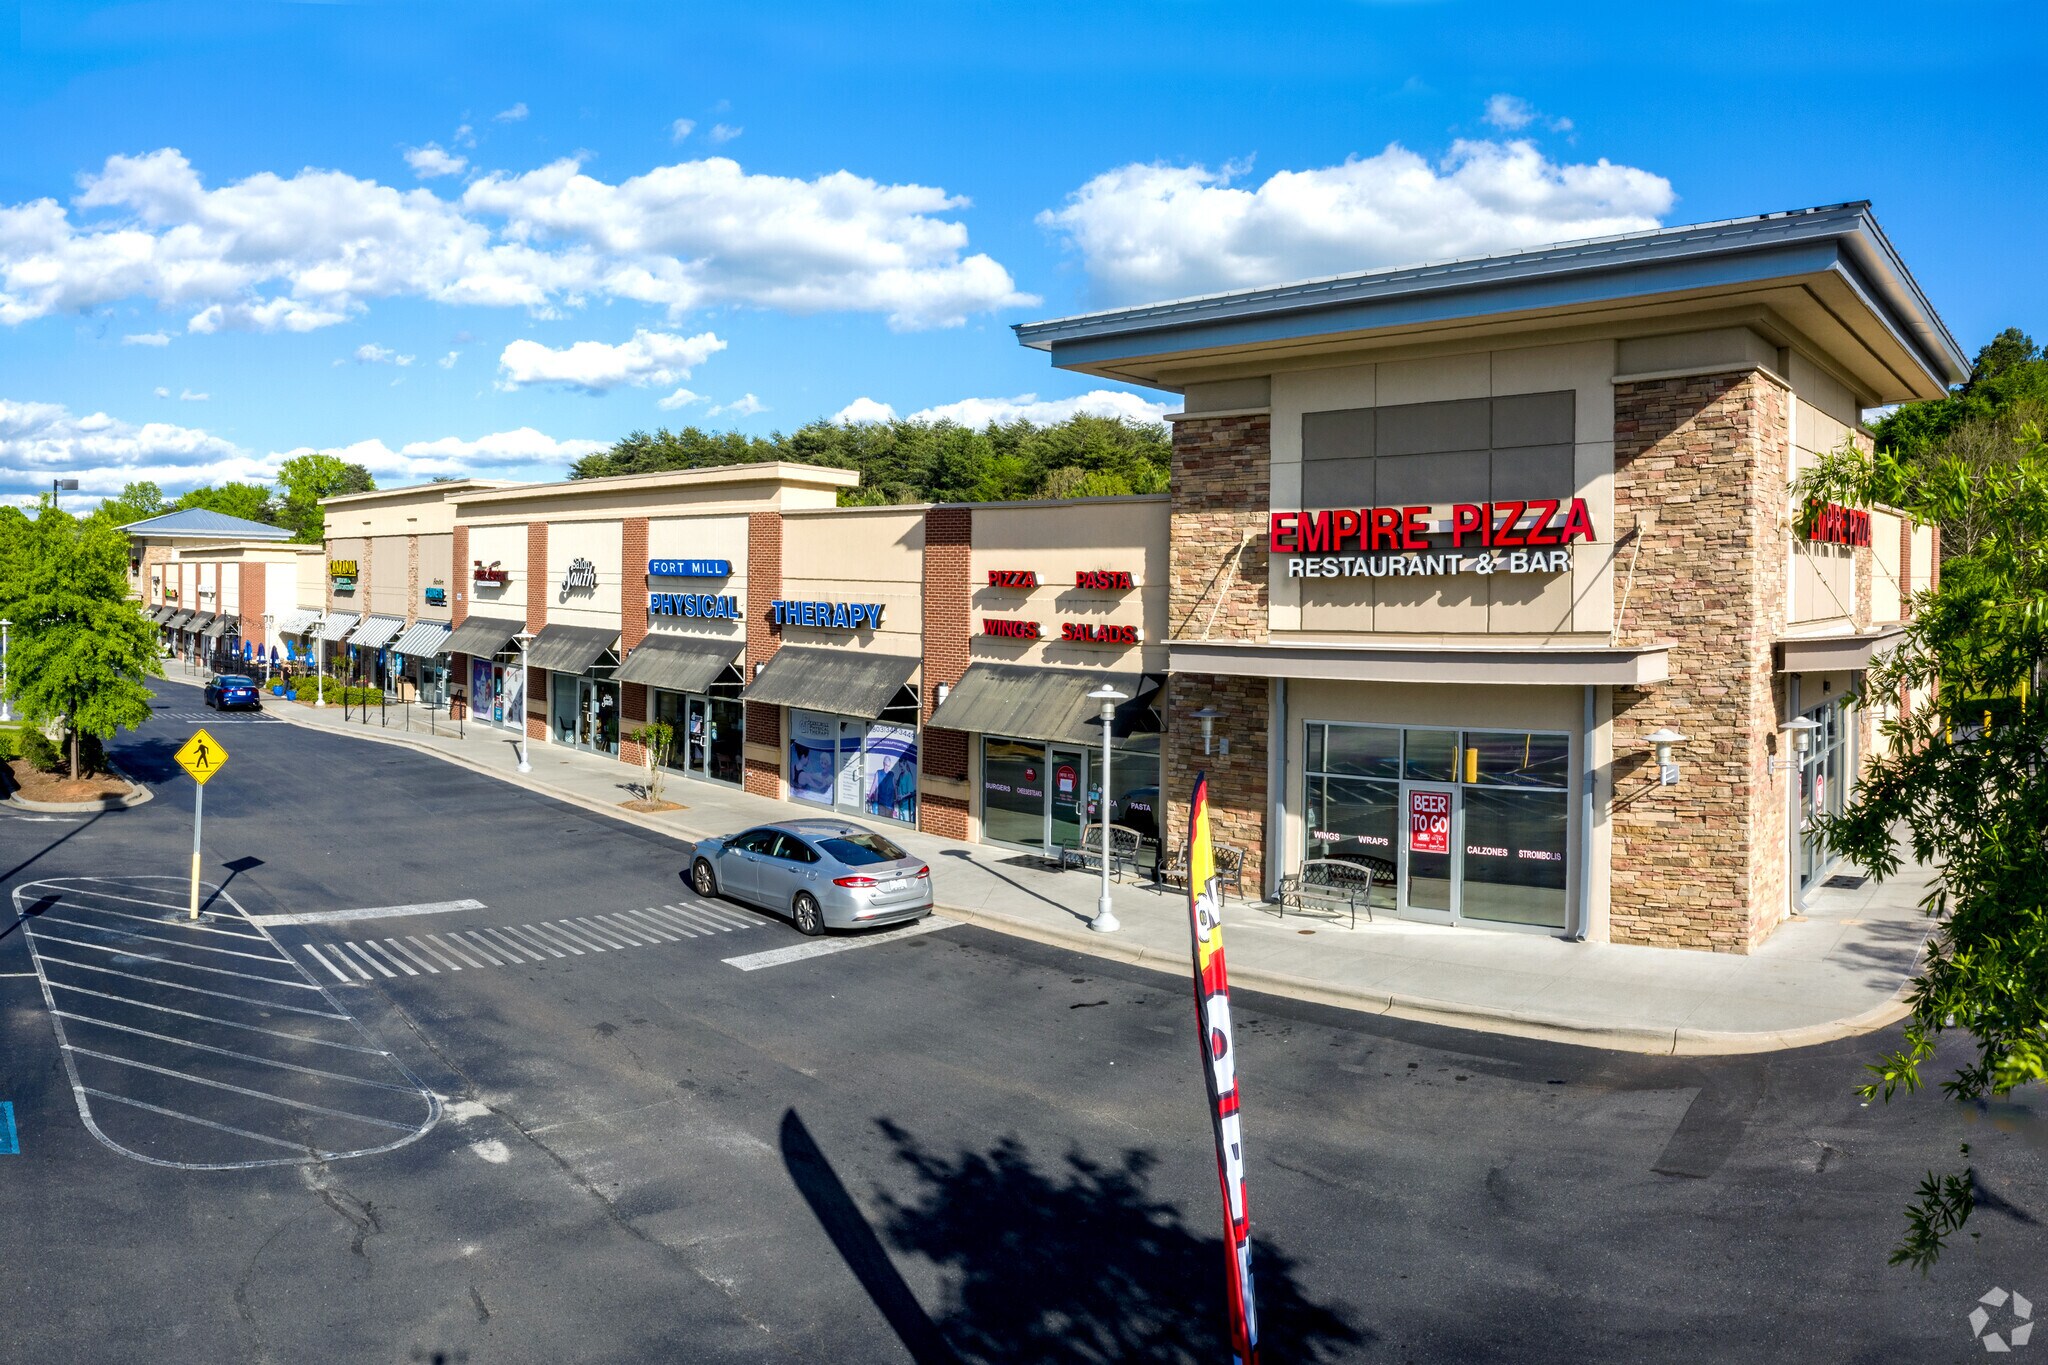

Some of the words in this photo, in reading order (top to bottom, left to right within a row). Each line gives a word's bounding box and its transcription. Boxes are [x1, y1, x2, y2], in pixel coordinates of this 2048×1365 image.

[1270, 505, 1432, 553] EMPIRE
[1453, 498, 1597, 548] PIZZA
[1849, 509, 1872, 547] PIZZA
[653, 562, 684, 574] FORT
[691, 562, 723, 574] MILL
[1288, 553, 1463, 578] RESTAURANT
[1475, 552, 1494, 575] &
[1509, 550, 1571, 574] BAR
[562, 565, 595, 593] South
[988, 570, 1038, 589] PIZZA
[1075, 571, 1135, 591] PASTA
[650, 593, 740, 620] PHYSICAL
[771, 600, 882, 629] THERAPY
[983, 618, 1041, 640] WINGS
[1061, 622, 1138, 645] SALADS
[986, 782, 1011, 793] BURGERS
[1130, 802, 1152, 812] PASTA
[1413, 795, 1447, 813] BEER
[1413, 813, 1428, 832] TO
[1430, 814, 1448, 834] GO
[1313, 830, 1341, 842] WINGS
[1357, 835, 1389, 846] WRAPS
[1466, 845, 1508, 858] CALZONES
[1517, 849, 1562, 862] STROMBOLIS
